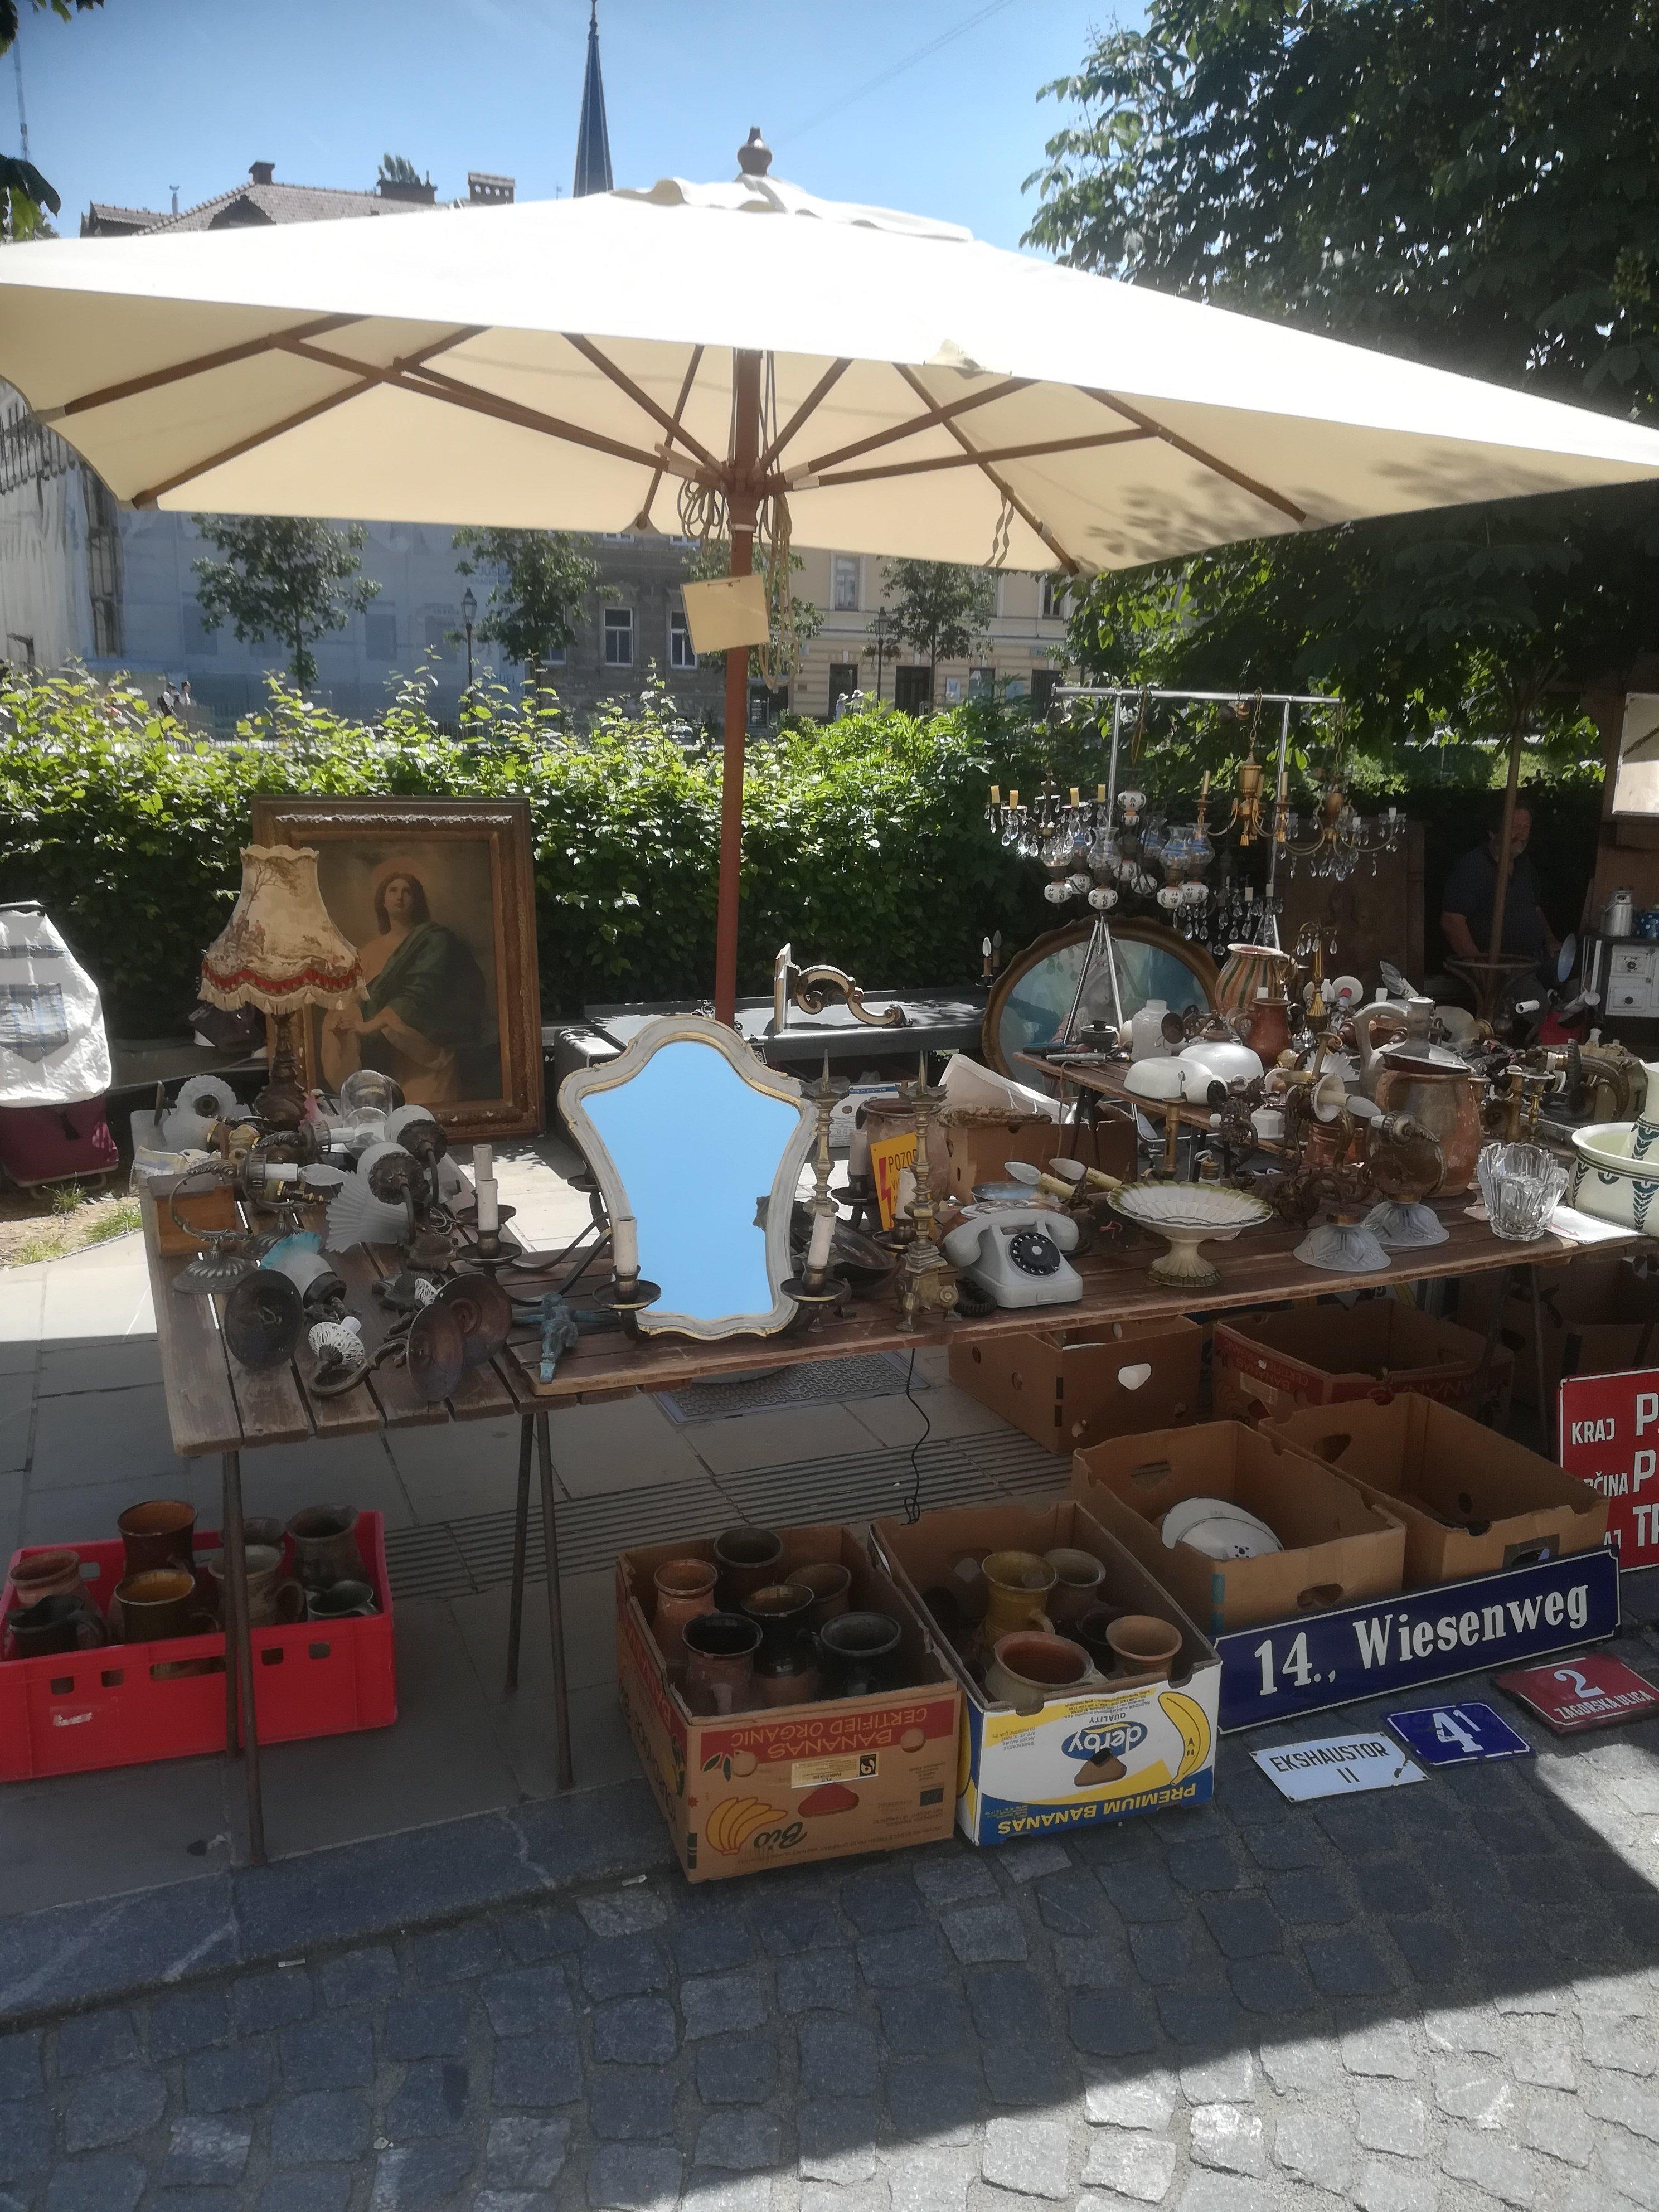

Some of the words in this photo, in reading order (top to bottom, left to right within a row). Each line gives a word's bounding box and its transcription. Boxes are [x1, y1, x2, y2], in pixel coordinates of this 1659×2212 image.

[1571, 1417, 1616, 1445] KRAJ
[1635, 1392, 1659, 1437] P
[1352, 1584, 1589, 1670] Wiesenweg
[1553, 1668, 1605, 1699] 2
[1088, 1713, 1126, 1724] QUALITY
[1553, 1697, 1619, 1720] ZAGORSKA
[1616, 1690, 1656, 1709] ULICA
[730, 1721, 824, 1748] ORGANIC
[830, 1707, 928, 1735] CERTIFIED
[767, 1728, 892, 1759] BANANAS
[1068, 1725, 1141, 1754] derby
[1268, 1741, 1391, 1772] EKSHAUSTOR
[1103, 1782, 1197, 1815] PREMIUM
[997, 1804, 1097, 1835] BANANAS
[753, 1821, 808, 1850] Bio
